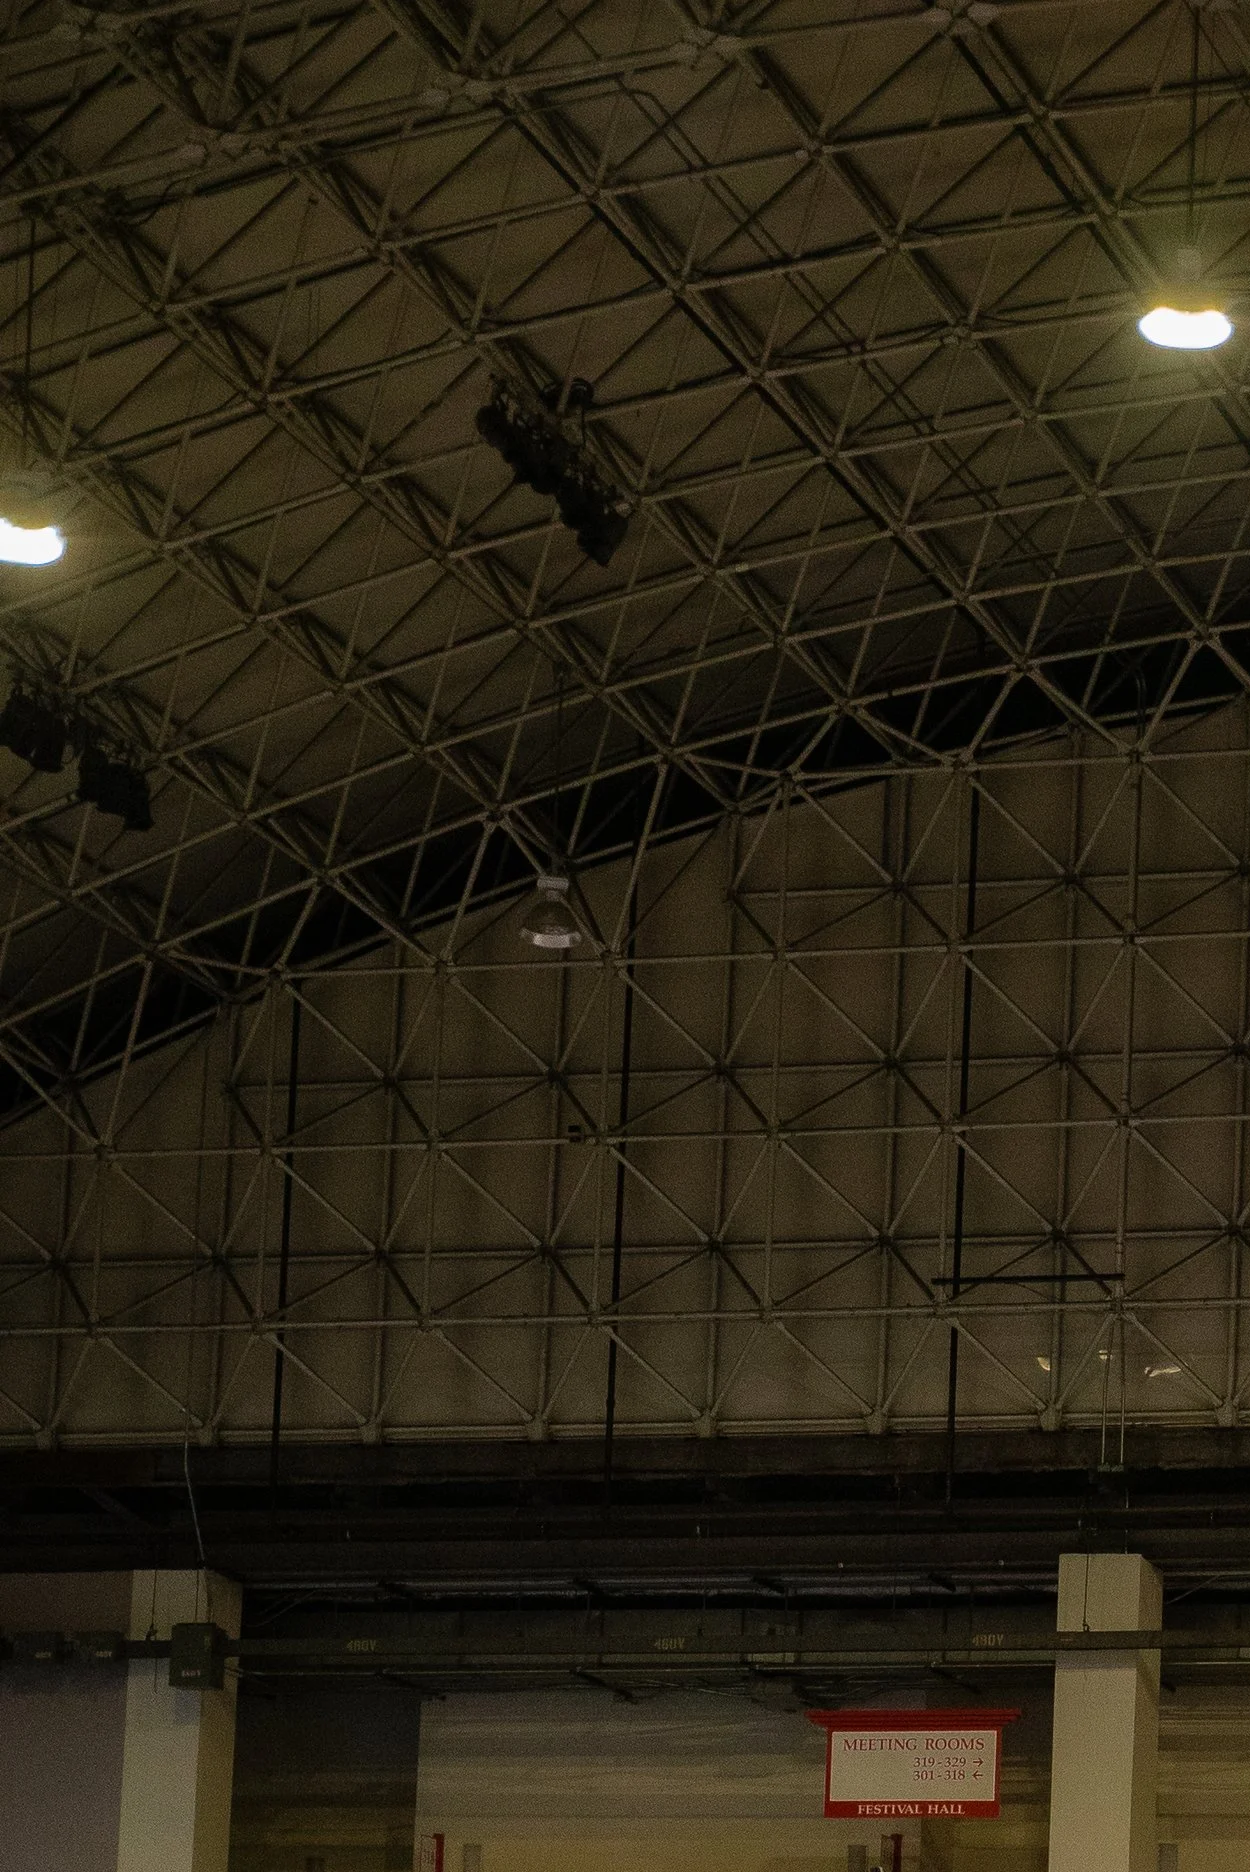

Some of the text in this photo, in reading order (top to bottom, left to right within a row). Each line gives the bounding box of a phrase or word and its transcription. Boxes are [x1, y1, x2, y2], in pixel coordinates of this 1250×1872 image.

[843, 1738, 985, 1751] MEETING ROOMS
[858, 1804, 966, 1815] FESTIVAL HALL
